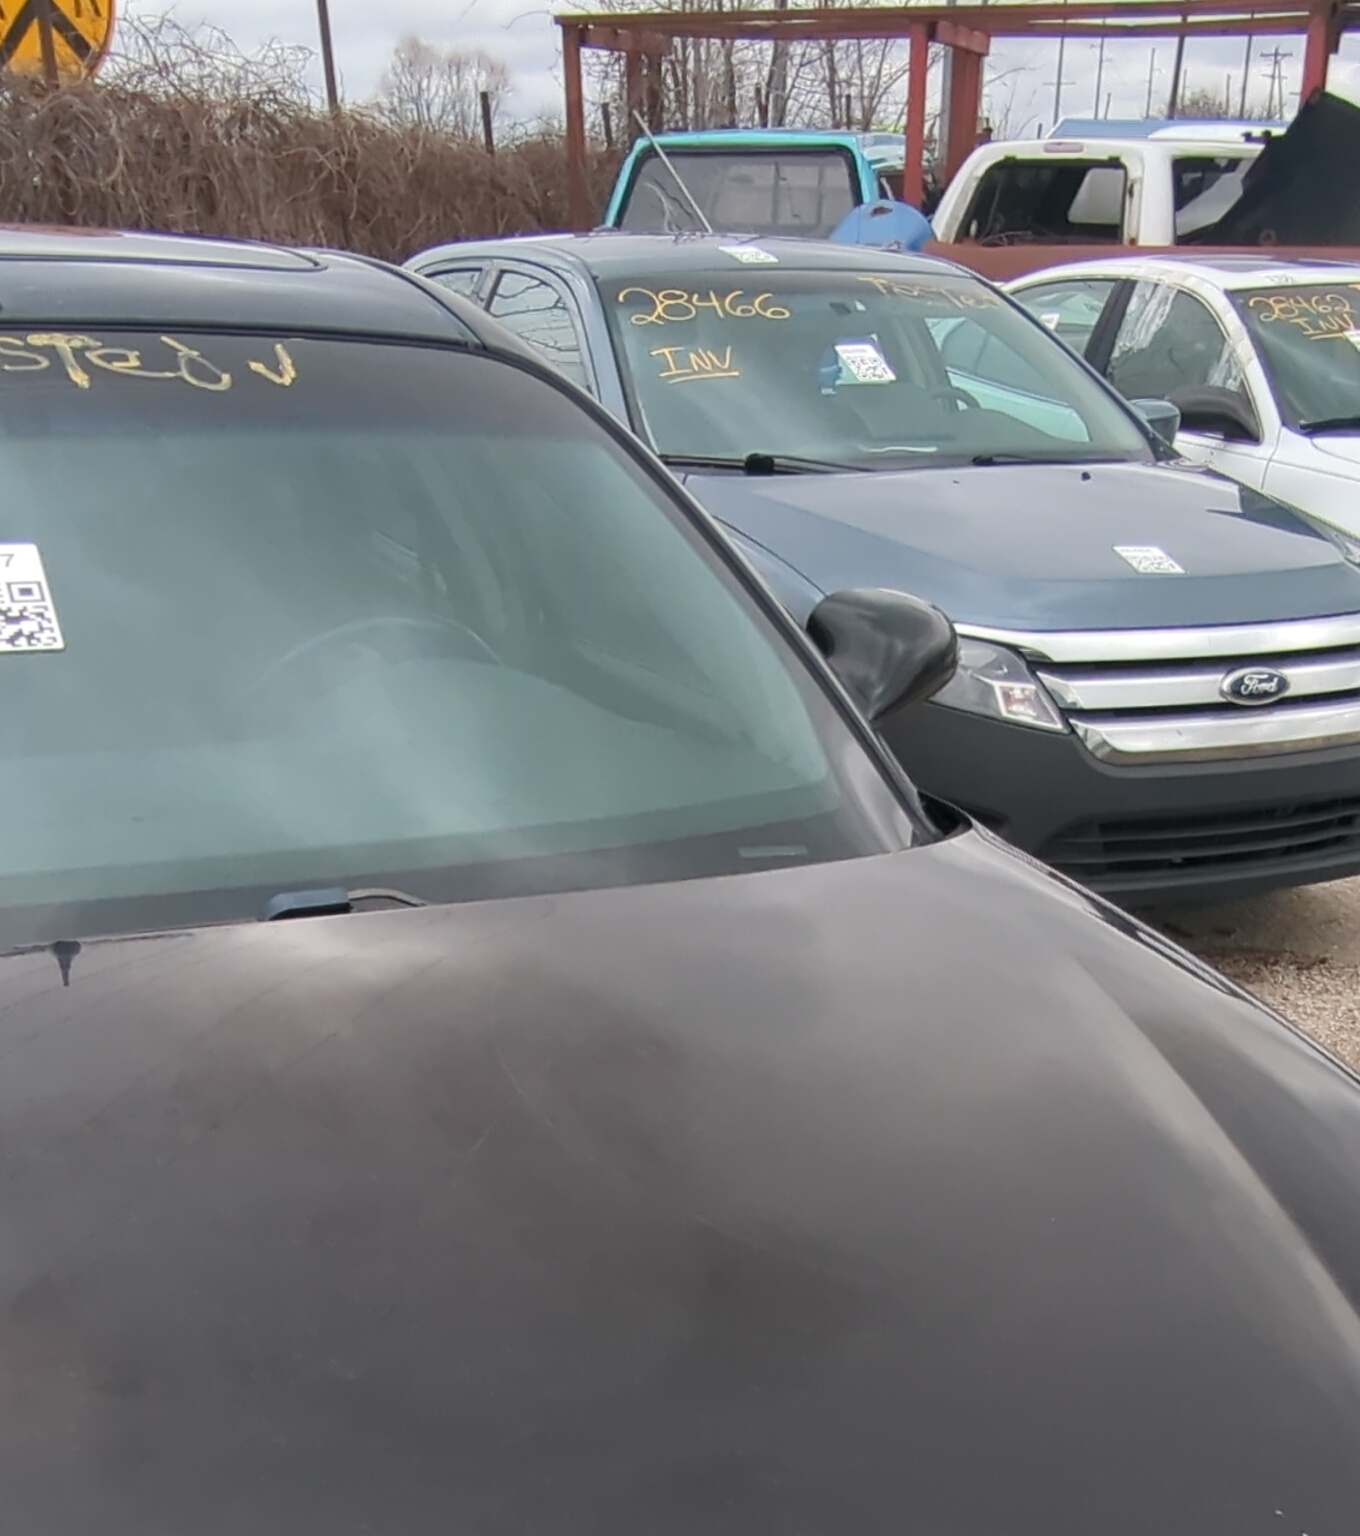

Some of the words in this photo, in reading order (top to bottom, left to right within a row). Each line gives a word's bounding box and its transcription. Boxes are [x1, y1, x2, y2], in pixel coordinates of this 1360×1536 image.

[619, 287, 791, 325] 28466
[1248, 293, 1358, 322] 28462
[1290, 313, 1355, 335] INV
[650, 345, 732, 377] INV
[1240, 674, 1279, 696] Ford
